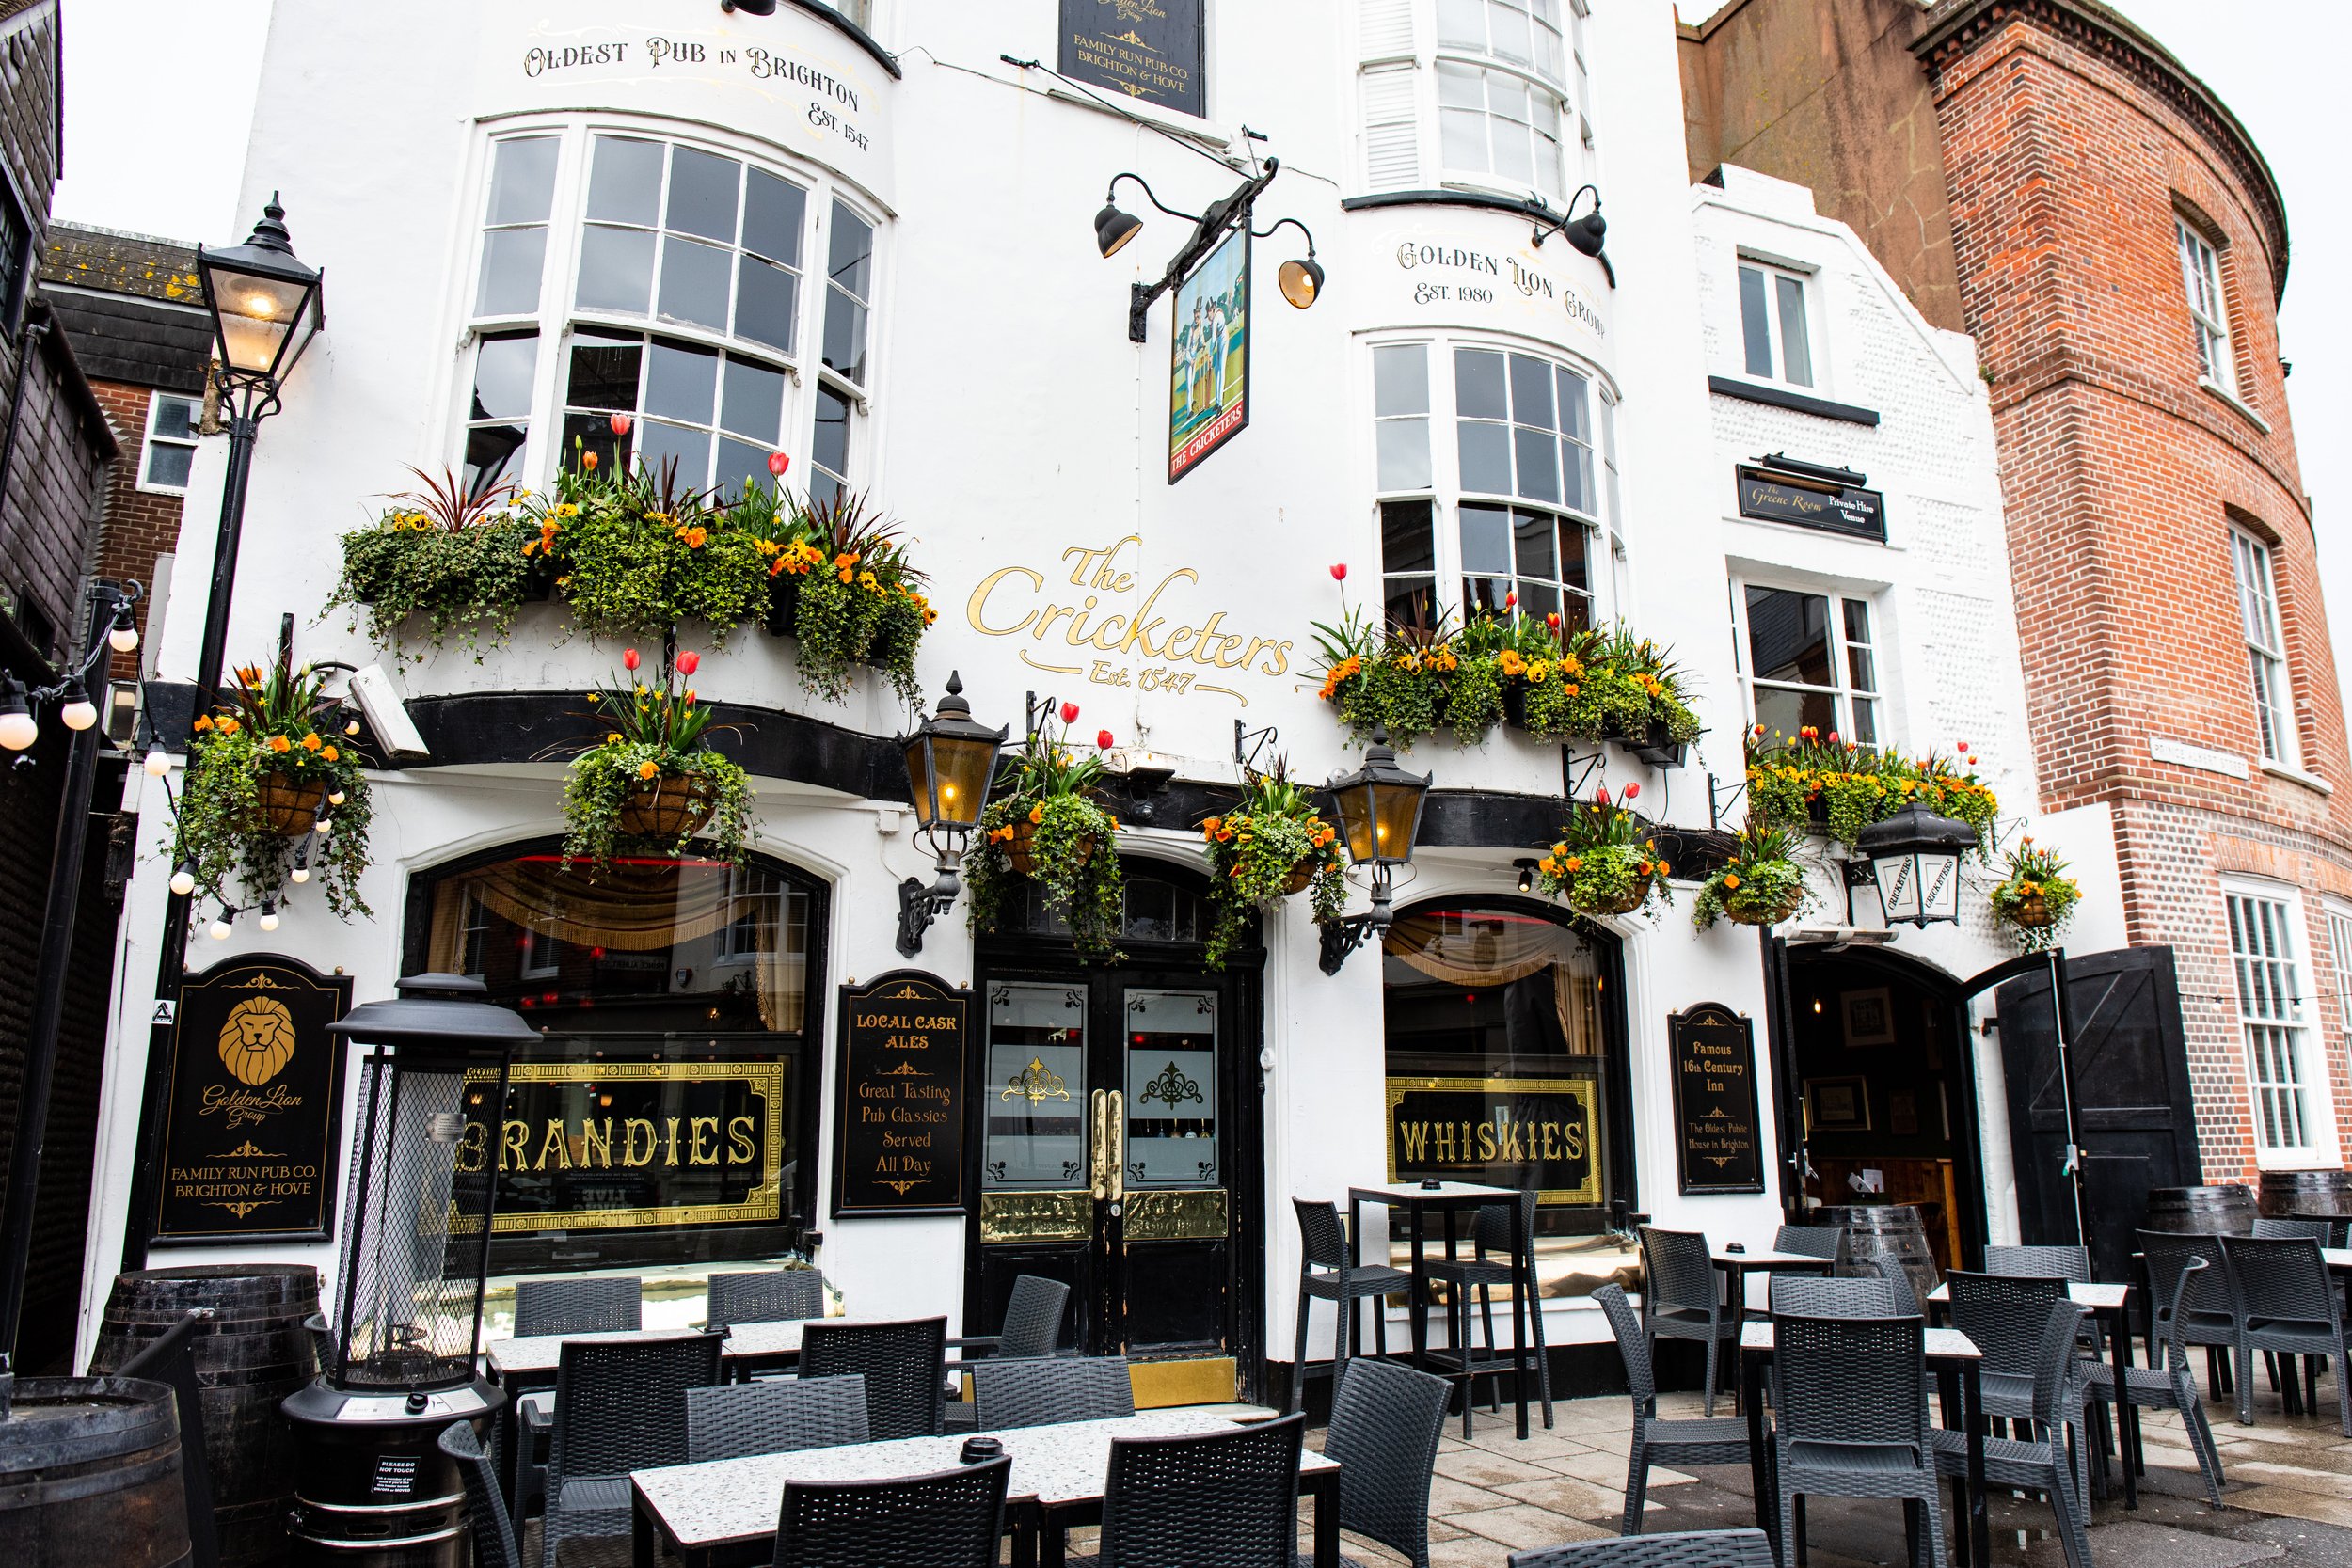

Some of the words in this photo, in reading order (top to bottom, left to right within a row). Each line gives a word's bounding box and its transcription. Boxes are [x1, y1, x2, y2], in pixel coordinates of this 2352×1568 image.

[1116, 4, 1143, 23] Group
[1073, 34, 1117, 56] FAMILY
[1119, 48, 1143, 64] RUN
[1145, 56, 1168, 72] PUB
[1169, 66, 1189, 81] CO.
[524, 42, 628, 78] OLDEST
[646, 37, 706, 70] PUB
[720, 49, 736, 64] IN
[745, 46, 859, 112] BRIGHTON
[1078, 50, 1137, 77] BRIGHTON
[1140, 70, 1152, 81] &
[1153, 74, 1185, 93] HOVE
[844, 123, 870, 152] 1547
[1397, 242, 1498, 276] GOLDEN
[1506, 257, 1553, 298] LION
[1458, 286, 1493, 304] 1980
[1171, 450, 1187, 472] THE
[1189, 404, 1243, 458] CRICKETERS
[1752, 488, 1788, 506] Greene
[1792, 495, 1822, 513] Room
[1768, 485, 1780, 495] The
[1828, 496, 1856, 510] Private
[1856, 500, 1874, 514] Hire
[1840, 509, 1866, 524] Venue
[1061, 535, 1143, 594] The
[966, 566, 1294, 676] Cricketers
[1089, 659, 1131, 688] Est.
[1138, 667, 1197, 695] 1547
[1888, 856, 1913, 911] CRICKETERS
[1925, 858, 1954, 909] CRICKETERS
[857, 1014, 911, 1029] LOCAL
[915, 1015, 957, 1030] CASK
[885, 1035, 929, 1049] ALES
[1693, 1041, 1731, 1055] Famous
[1684, 1060, 1701, 1073] 16th
[1704, 1060, 1743, 1076] Century
[859, 1082, 896, 1099] Great
[901, 1082, 951, 1107] Tasting
[1707, 1079, 1724, 1092] Inn
[199, 1085, 262, 1116] Golden
[259, 1085, 303, 1112] Lion
[226, 1106, 265, 1129] Group
[862, 1106, 886, 1123] Pub
[891, 1107, 948, 1123] Classics
[1689, 1122, 1703, 1133] The
[1705, 1123, 1726, 1133] Oldest
[1728, 1123, 1748, 1134] Public
[454, 1117, 755, 1172] BRANDIES
[882, 1131, 931, 1148] Served
[1400, 1120, 1584, 1163] WHISKIES
[1689, 1138, 1710, 1149] House
[1711, 1139, 1719, 1149] in
[1721, 1138, 1749, 1154] Brighton
[171, 1167, 226, 1180] FAMILY
[228, 1166, 259, 1180] RUN
[262, 1165, 290, 1179] PUB
[293, 1165, 317, 1178] CO.
[876, 1155, 897, 1172] All
[902, 1155, 932, 1176] Day
[175, 1184, 250, 1197] BRIGHTON
[252, 1185, 268, 1196] &
[271, 1182, 310, 1195] HOVE
